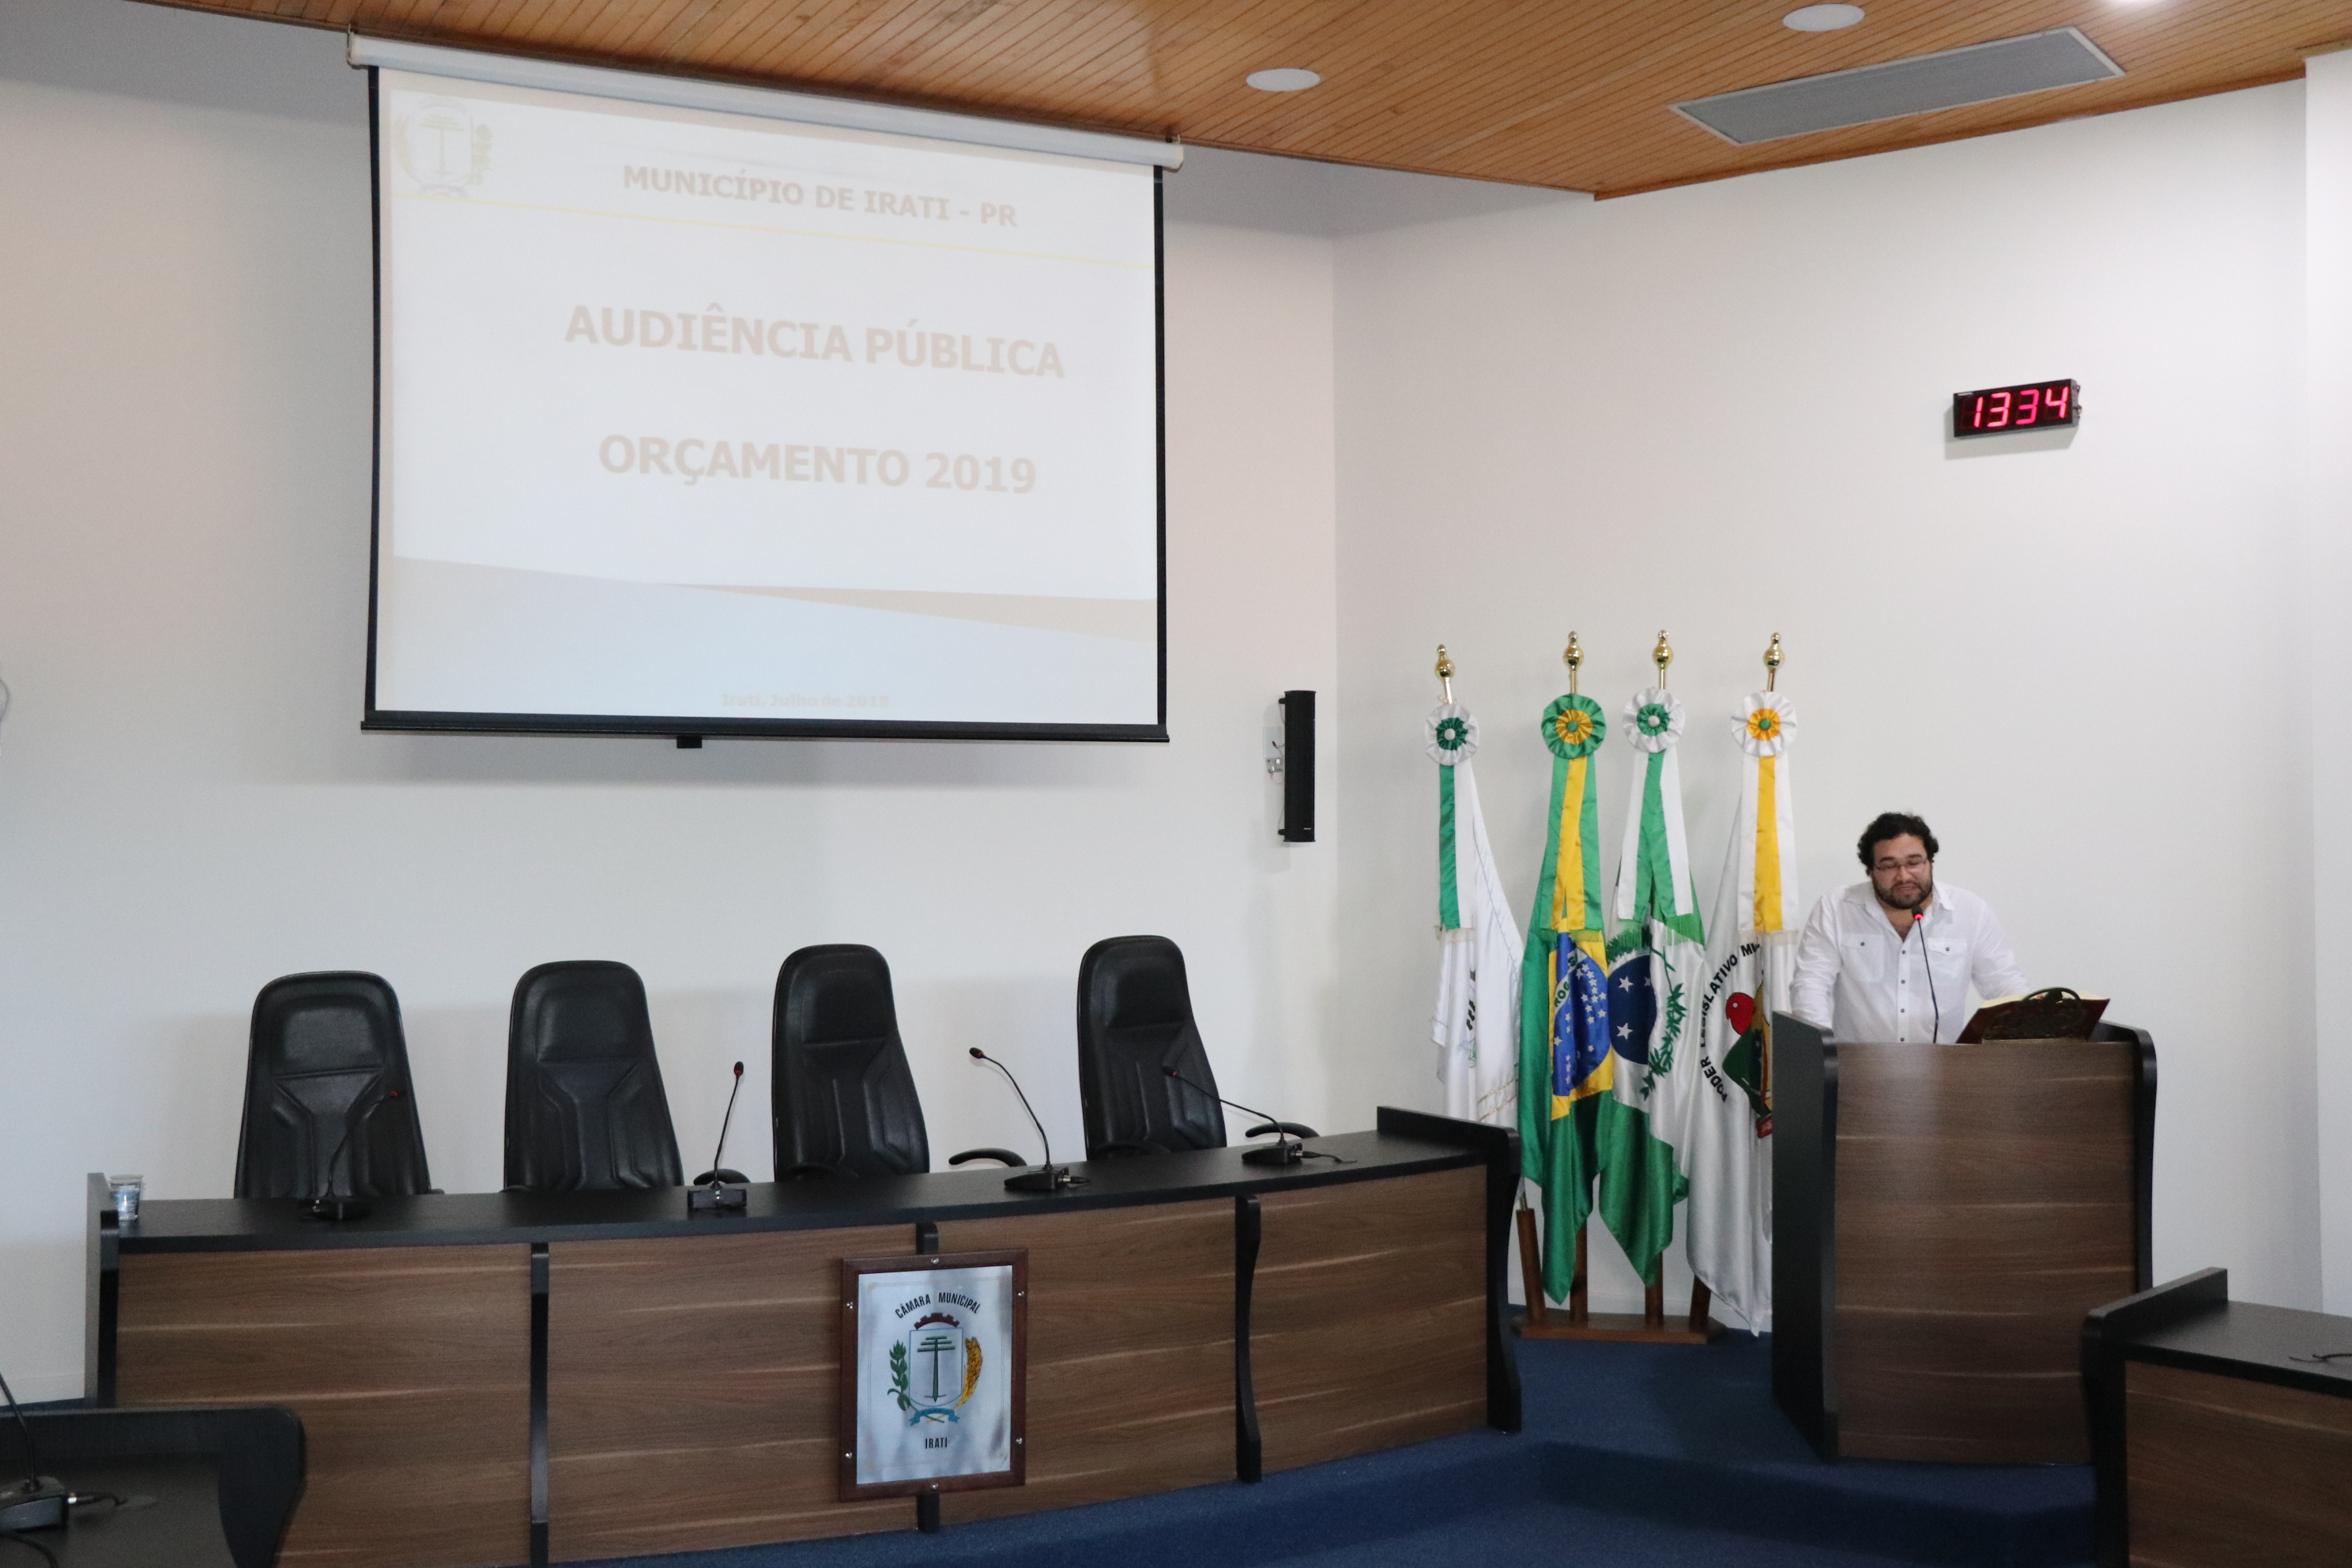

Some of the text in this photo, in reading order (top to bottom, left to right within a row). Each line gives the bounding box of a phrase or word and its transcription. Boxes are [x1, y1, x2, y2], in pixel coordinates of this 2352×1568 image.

[622, 164, 805, 207] MUNICÍPIO
[815, 184, 854, 211] DE
[864, 189, 950, 223] IRATI
[980, 201, 1019, 228] PR
[564, 302, 1066, 379] AUDIÊNCIA PÚBLICA
[598, 434, 1037, 495] ORÇAMENTO 2019
[1700, 1056, 1728, 1102] PODER
[895, 1292, 981, 1319] CÂMARA MUNICIPAL
[925, 1437, 948, 1449] IRATI
